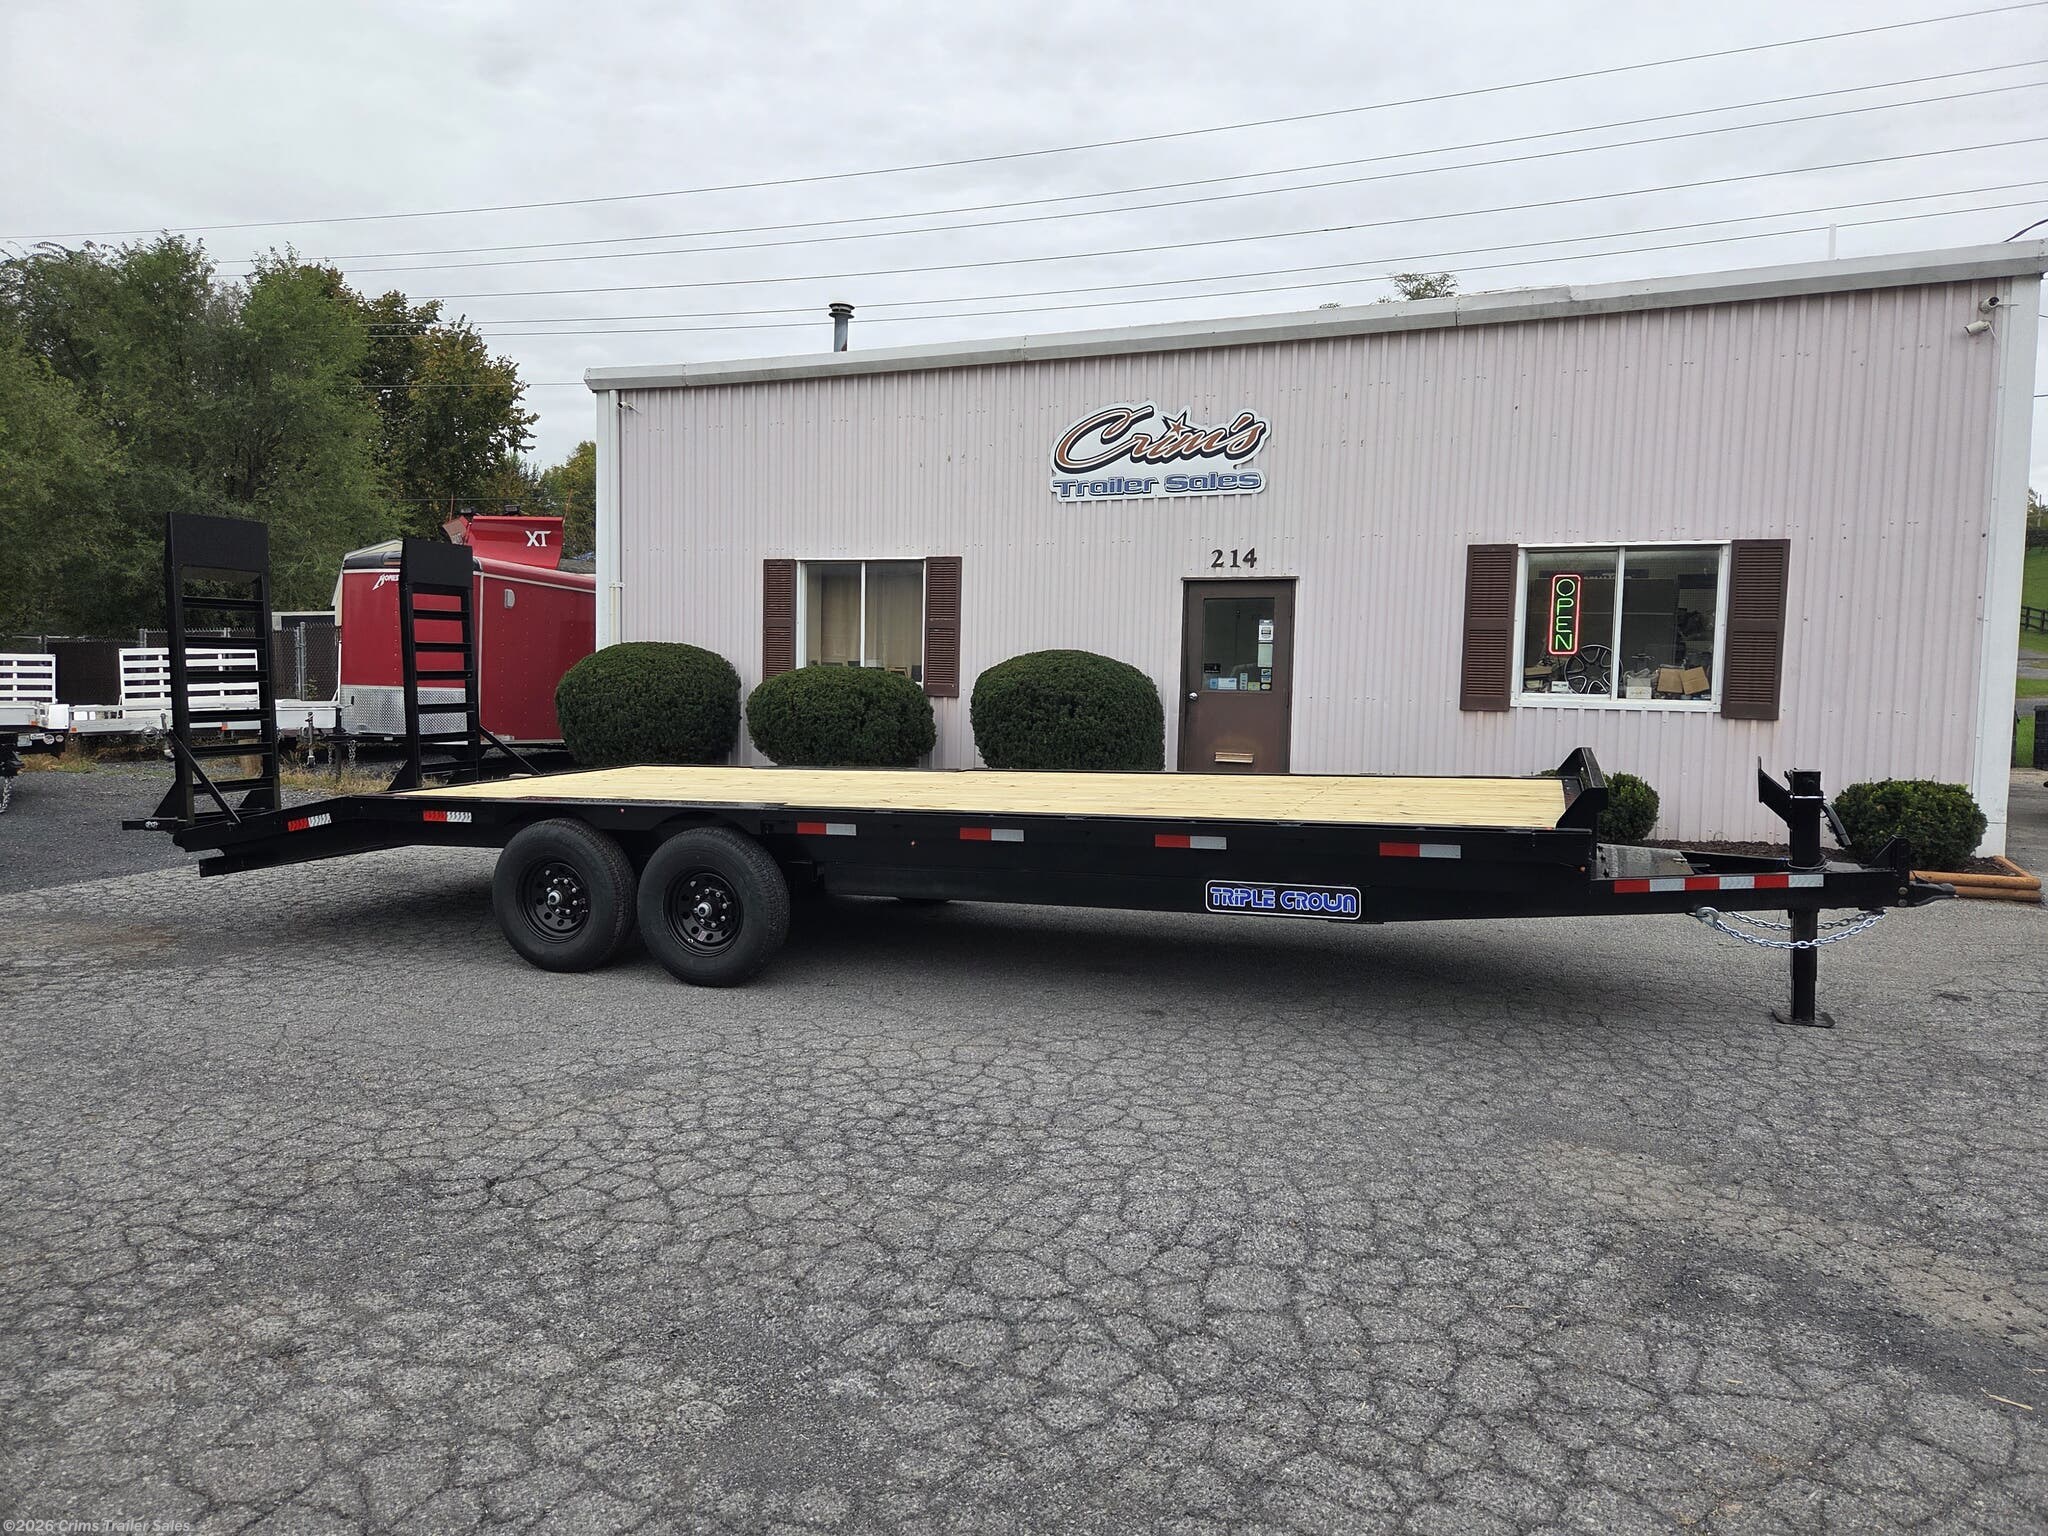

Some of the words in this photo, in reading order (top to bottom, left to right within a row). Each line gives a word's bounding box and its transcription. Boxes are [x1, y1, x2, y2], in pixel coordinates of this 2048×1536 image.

[1054, 404, 1267, 474] Crim's
[1053, 475, 1158, 497] Trailer
[1164, 471, 1262, 493] Sales
[525, 530, 552, 547] XT
[1211, 547, 1257, 568] 214
[1555, 578, 1576, 650] OPEN
[1281, 890, 1357, 914] CROWN
